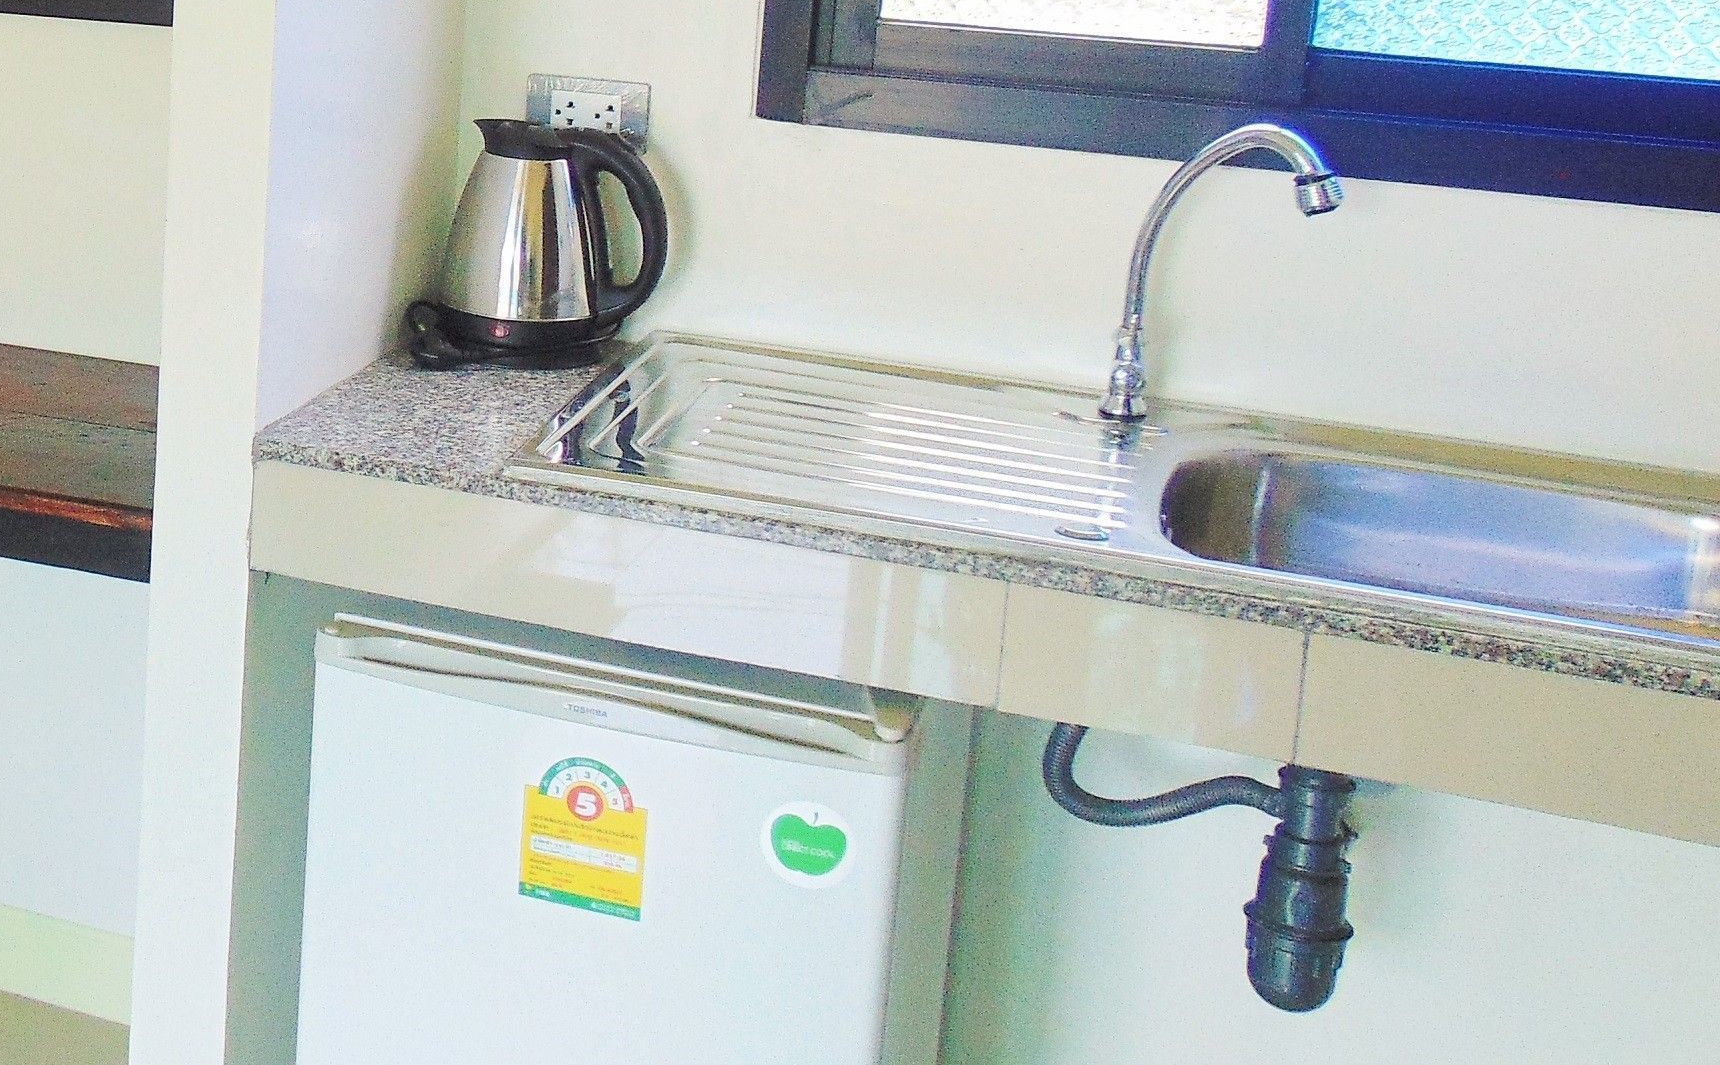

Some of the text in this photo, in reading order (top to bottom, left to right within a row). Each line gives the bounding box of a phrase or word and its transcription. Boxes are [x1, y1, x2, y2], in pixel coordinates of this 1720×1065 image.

[565, 773, 572, 781] 2
[583, 771, 591, 779] 3
[574, 791, 598, 817] 5
